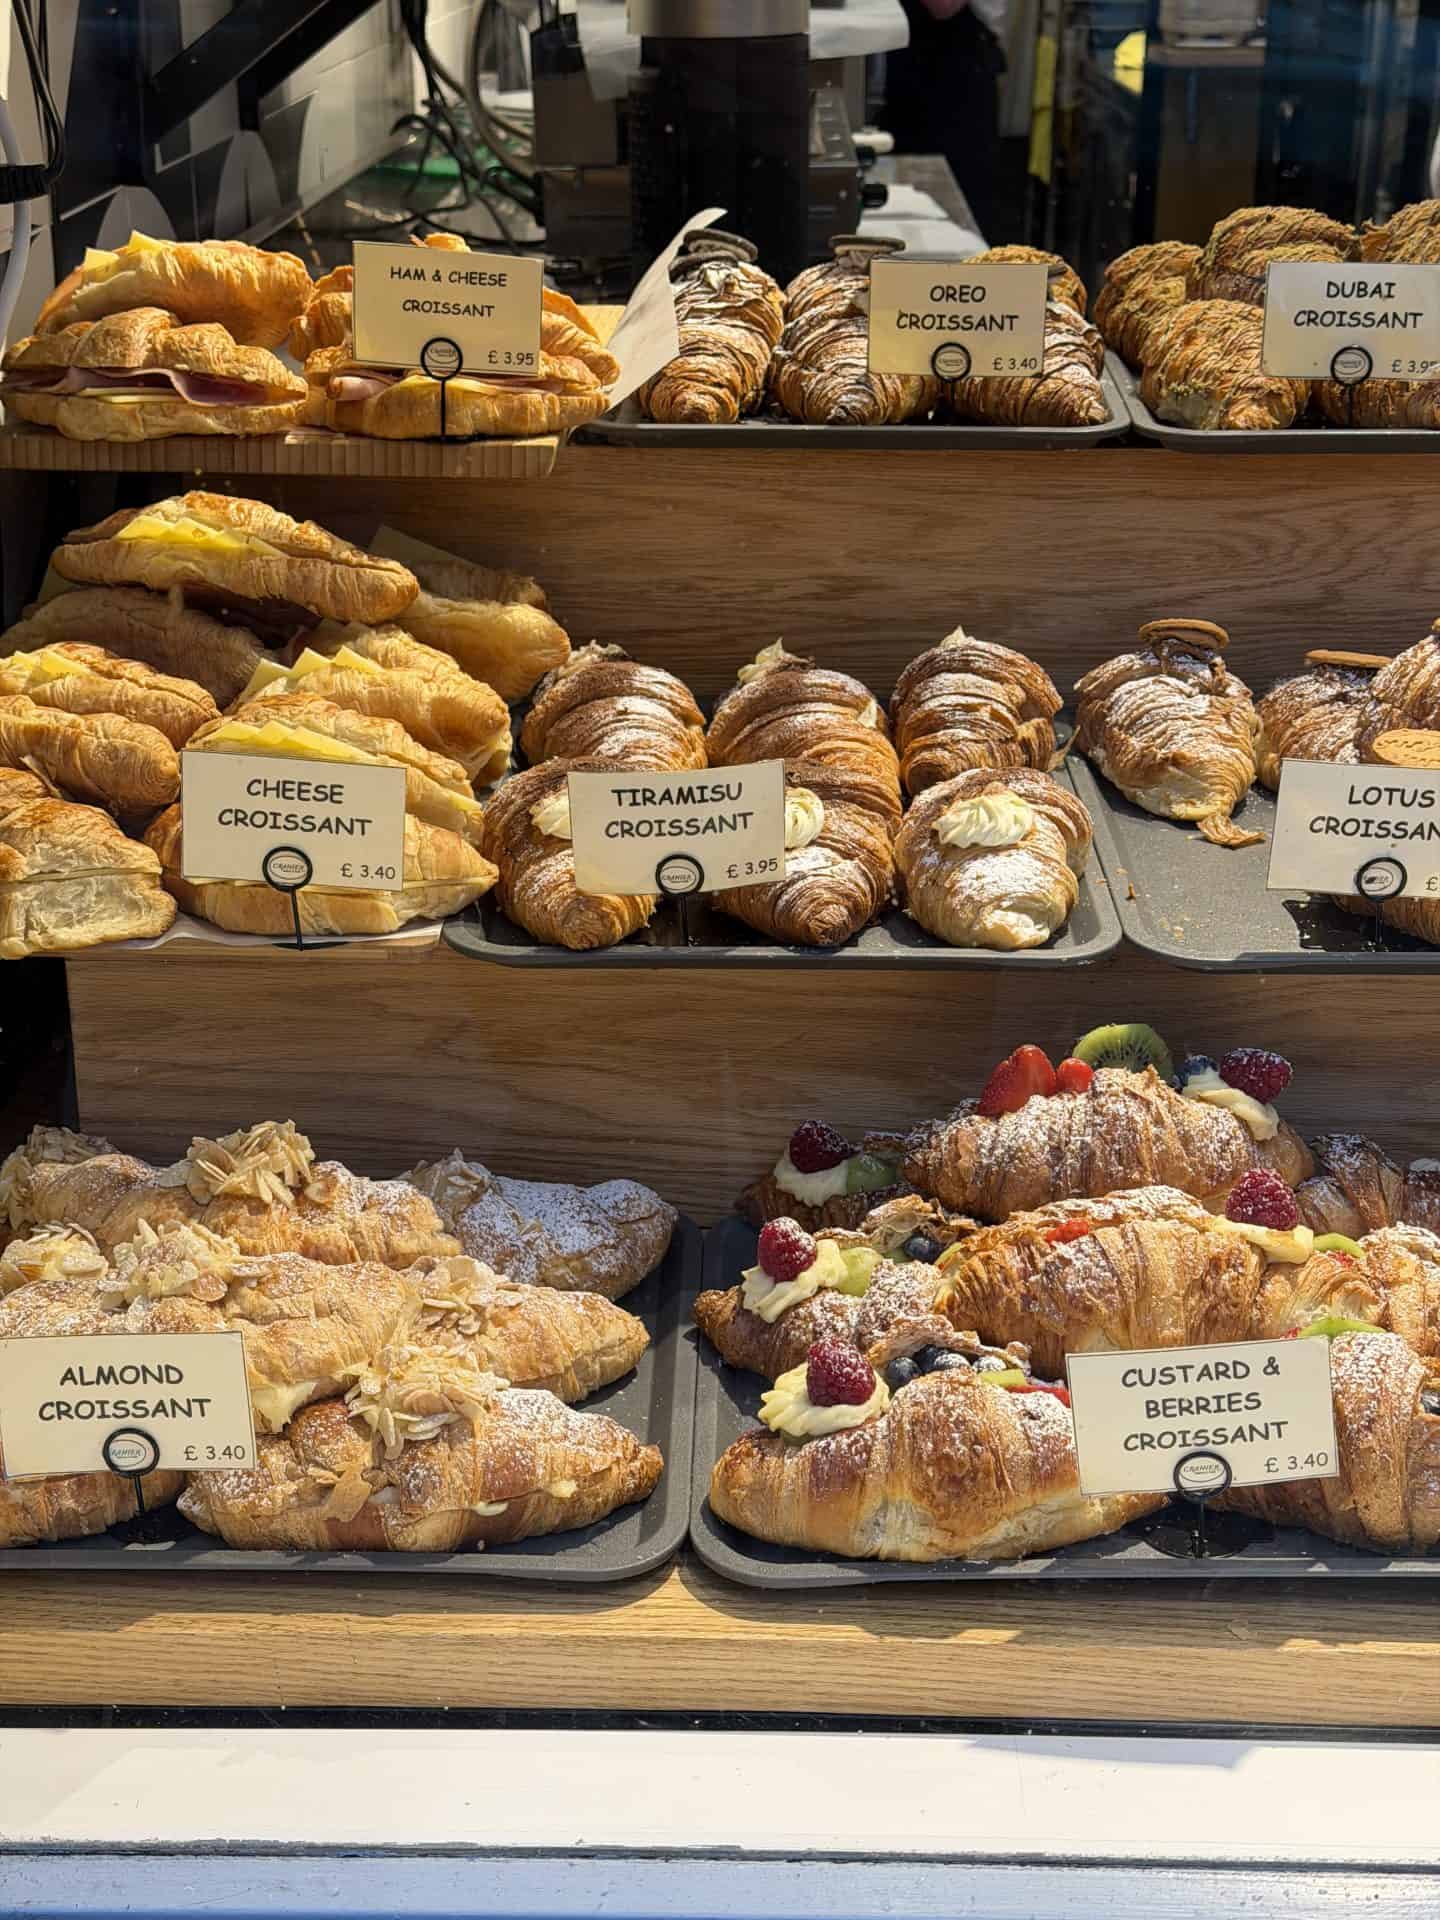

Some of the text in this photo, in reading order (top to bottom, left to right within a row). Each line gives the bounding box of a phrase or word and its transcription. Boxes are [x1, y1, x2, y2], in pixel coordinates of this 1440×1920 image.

[391, 267, 507, 287] HAM & CHEESE
[930, 285, 986, 303] OREO
[1327, 281, 1396, 298] DUBAI
[402, 299, 495, 317] CROISSANT
[897, 310, 1019, 331] CROISSANT
[1294, 310, 1423, 328] CROISSANT
[488, 350, 534, 365] £ 3.95
[992, 357, 1037, 371] £ 3.40
[247, 779, 344, 804] CHEESE
[611, 782, 742, 806] TIRAMISU
[1349, 785, 1435, 808] LOTUS
[218, 809, 372, 836] CROISSANT
[605, 812, 753, 838] CROISSANT
[1310, 816, 1440, 840] CROISSAN
[340, 863, 395, 879] £ 3.40
[726, 858, 777, 878] £ 3.95
[60, 1364, 183, 1386] ALMOND
[1122, 1356, 1280, 1387] CUSTARD &
[39, 1398, 211, 1421] CROISSANT
[1145, 1392, 1261, 1419] BERRIES
[1124, 1421, 1288, 1451] CROISSANT
[184, 1445, 245, 1461] £ 3.40
[1264, 1452, 1328, 1472] £ 3.40
